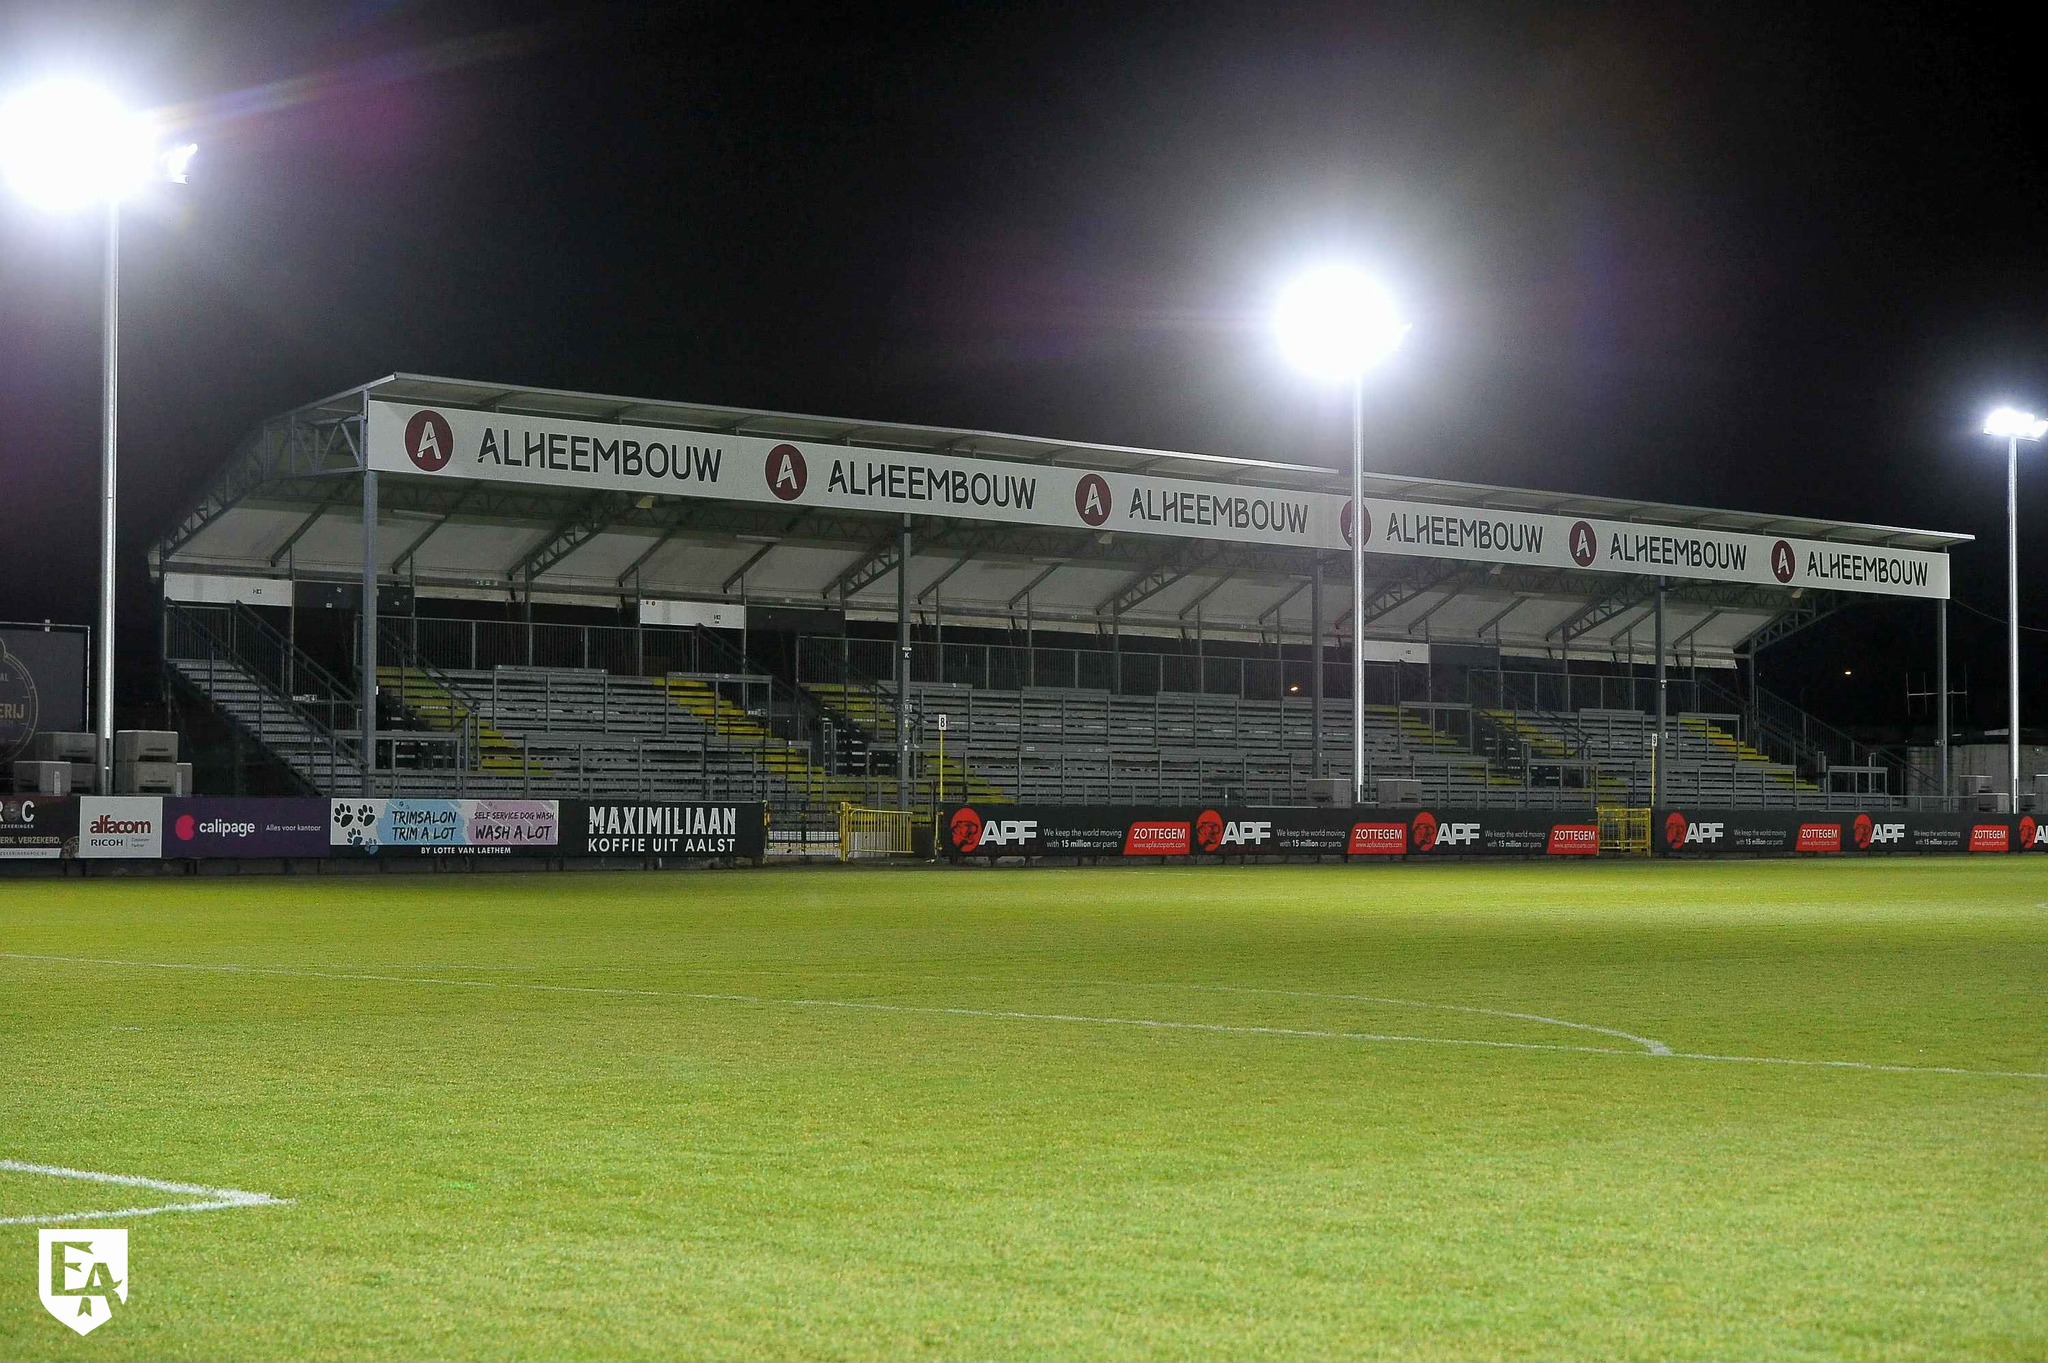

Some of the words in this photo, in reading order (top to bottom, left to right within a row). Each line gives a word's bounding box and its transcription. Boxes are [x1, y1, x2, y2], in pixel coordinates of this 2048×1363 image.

[478, 427, 722, 483] ALHEEMBOUW
[827, 459, 1037, 510] ALHEEMBOUW
[1129, 488, 1309, 534] ALHEEMBOUW
[1387, 512, 1544, 554] ALHEEMBOUW
[1610, 533, 1747, 571] ALHEEMBOUW
[1808, 551, 1928, 587] ALHEEMBOUW
[90, 815, 151, 834] alfacom
[392, 810, 457, 824] TRIMSALON
[474, 812, 491, 820] SELF
[492, 812, 519, 820] SERVICE
[520, 812, 535, 820] DOG
[536, 812, 555, 820] WASH
[588, 807, 736, 835] MAXIMILIAAN
[199, 818, 255, 837] calipage
[392, 827, 419, 841] TRIM
[420, 828, 429, 841] A
[433, 827, 456, 841] LOT
[475, 825, 511, 841] WASH
[514, 825, 523, 841] A
[527, 825, 552, 841] LOT
[979, 820, 1037, 846] APF
[1043, 828, 1054, 836] We
[1055, 828, 1070, 838] keep
[1071, 828, 1081, 836] the
[1083, 828, 1099, 836] world
[1100, 829, 1122, 838] moving
[1134, 828, 1186, 839] ZOTTEGEM
[1220, 821, 1272, 845] APF
[1277, 829, 1286, 837] We
[1287, 829, 1300, 838] keep
[1301, 829, 1310, 837] the
[1310, 829, 1325, 837] world
[1326, 829, 1346, 838] moving
[1355, 829, 1402, 840] ZOTTEGEM
[1435, 823, 1481, 845] APF
[1554, 830, 1595, 840] ZOTTEGEM
[1684, 822, 1724, 843] APF
[1802, 829, 1838, 838] ZOTTEGEM
[1870, 824, 1905, 844] APF
[1974, 830, 2005, 839] ZOTTEGEM
[2034, 825, 2048, 844] A
[91, 839, 123, 847] RICOH
[588, 838, 645, 852] KOFFIE
[653, 838, 679, 852] UIT
[685, 838, 736, 852] AALST
[1102, 841, 1118, 849] parts
[1328, 841, 1342, 849] parts
